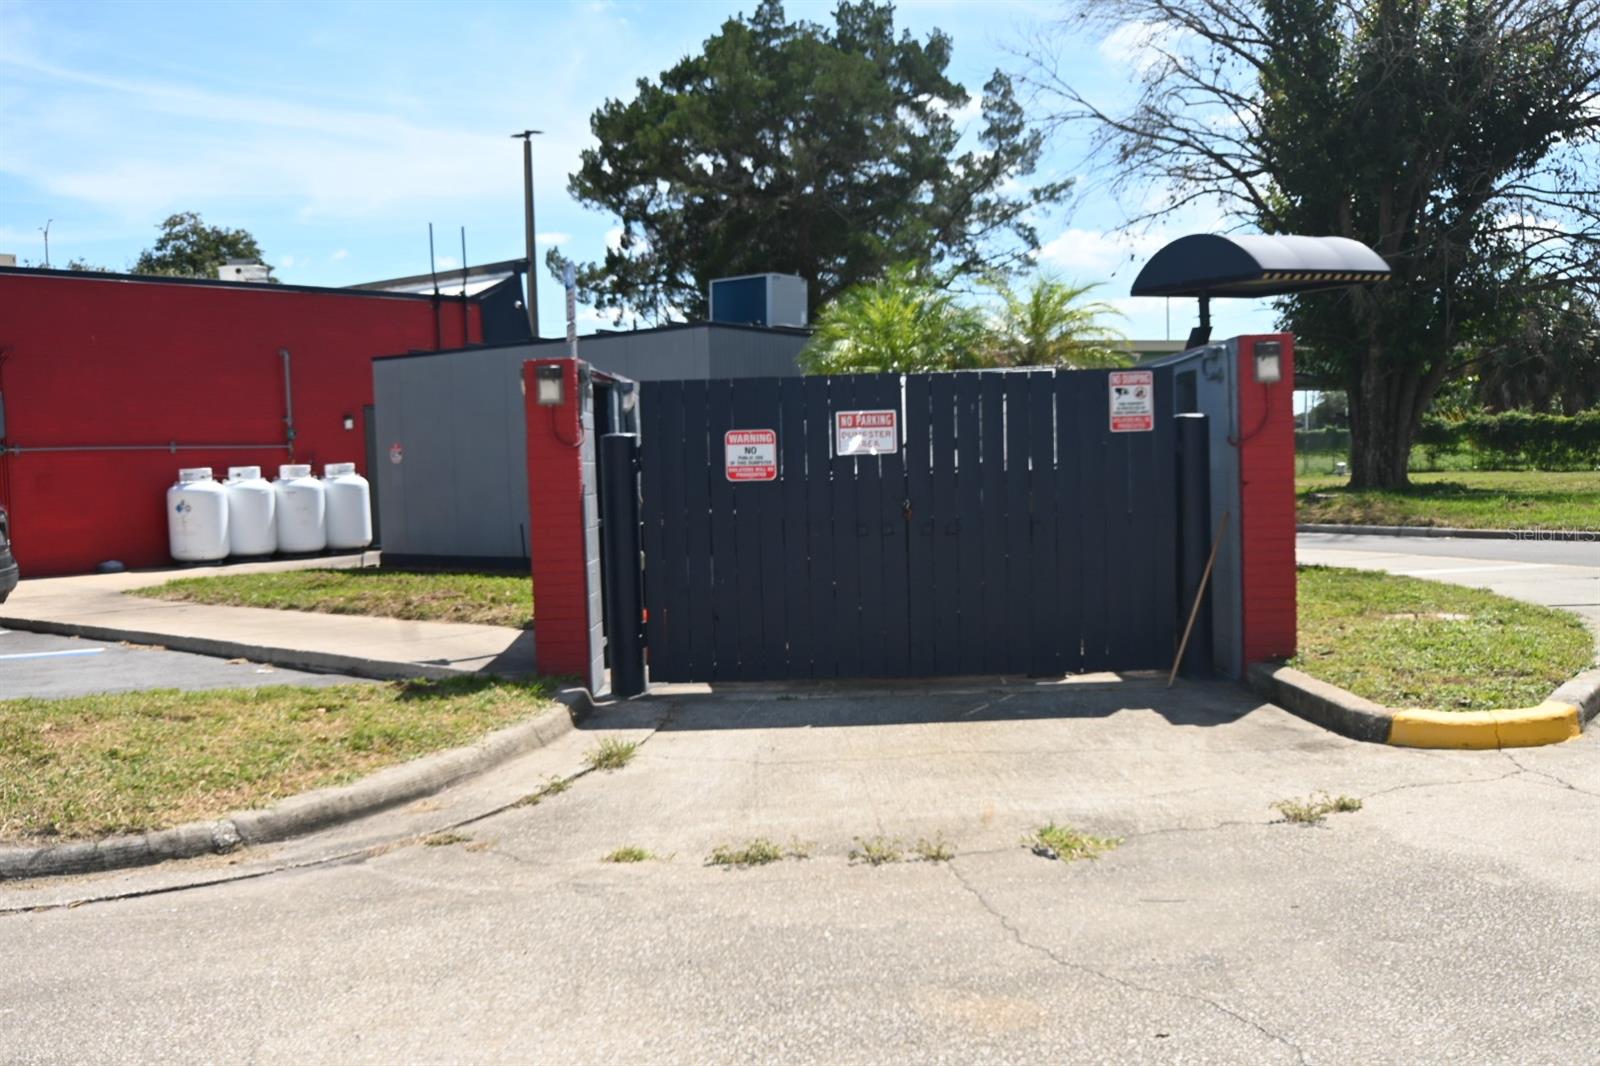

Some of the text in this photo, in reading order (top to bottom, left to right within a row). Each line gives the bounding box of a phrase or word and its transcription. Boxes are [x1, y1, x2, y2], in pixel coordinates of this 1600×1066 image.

[840, 414, 892, 427] NO PARKING
[729, 433, 772, 444] WARNING
[855, 440, 881, 448] REA
[744, 446, 757, 455] NO
